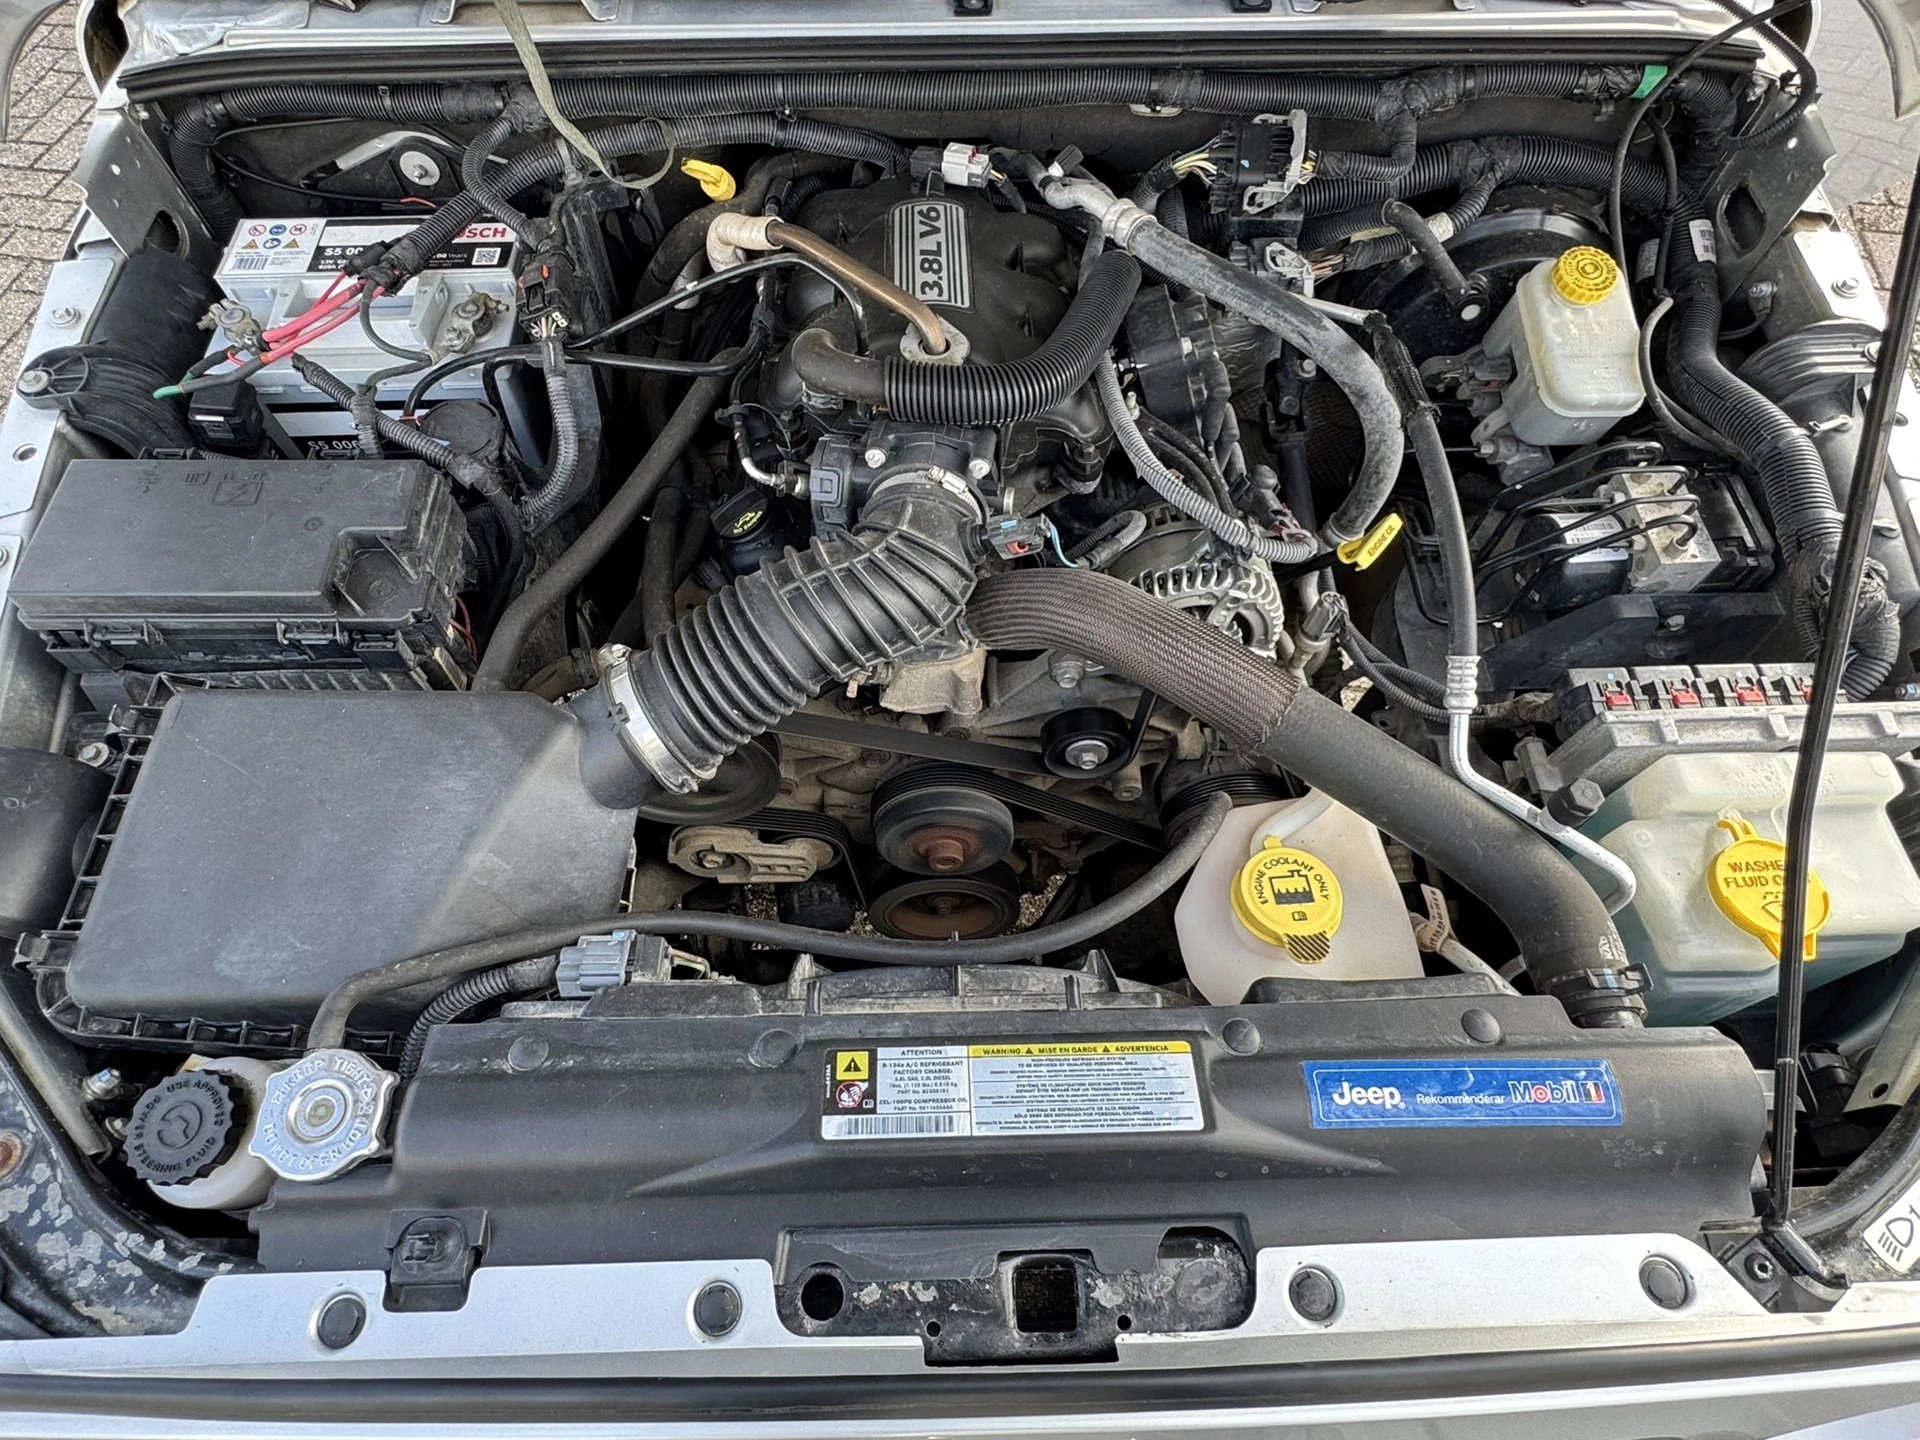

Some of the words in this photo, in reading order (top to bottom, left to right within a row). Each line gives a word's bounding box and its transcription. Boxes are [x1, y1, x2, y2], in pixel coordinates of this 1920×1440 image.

[917, 206, 942, 240] V6
[324, 247, 343, 256] S5
[919, 241, 944, 298] 3.8L
[308, 440, 329, 450] S5
[1727, 859, 1784, 873] WASHE
[1254, 869, 1269, 905] ENGINE
[1263, 857, 1315, 873] COOLANT
[1313, 873, 1330, 901] ONLY
[1723, 875, 1769, 889] FLUID
[334, 1057, 374, 1086] TIGHT
[906, 1061, 919, 1069] A/C
[919, 1060, 964, 1068] REFRIGERANT
[166, 1080, 191, 1093] USE
[193, 1081, 225, 1127] APPROVED
[913, 1097, 957, 1105] COMPRESSOR
[1332, 1077, 1401, 1110] Jeep
[1416, 1092, 1505, 1106] Rekommenderar
[1508, 1080, 1579, 1104] Mobil
[134, 1143, 181, 1173] STEERING
[185, 1136, 216, 1167] FLUID
[300, 1147, 343, 1170] OPEN
